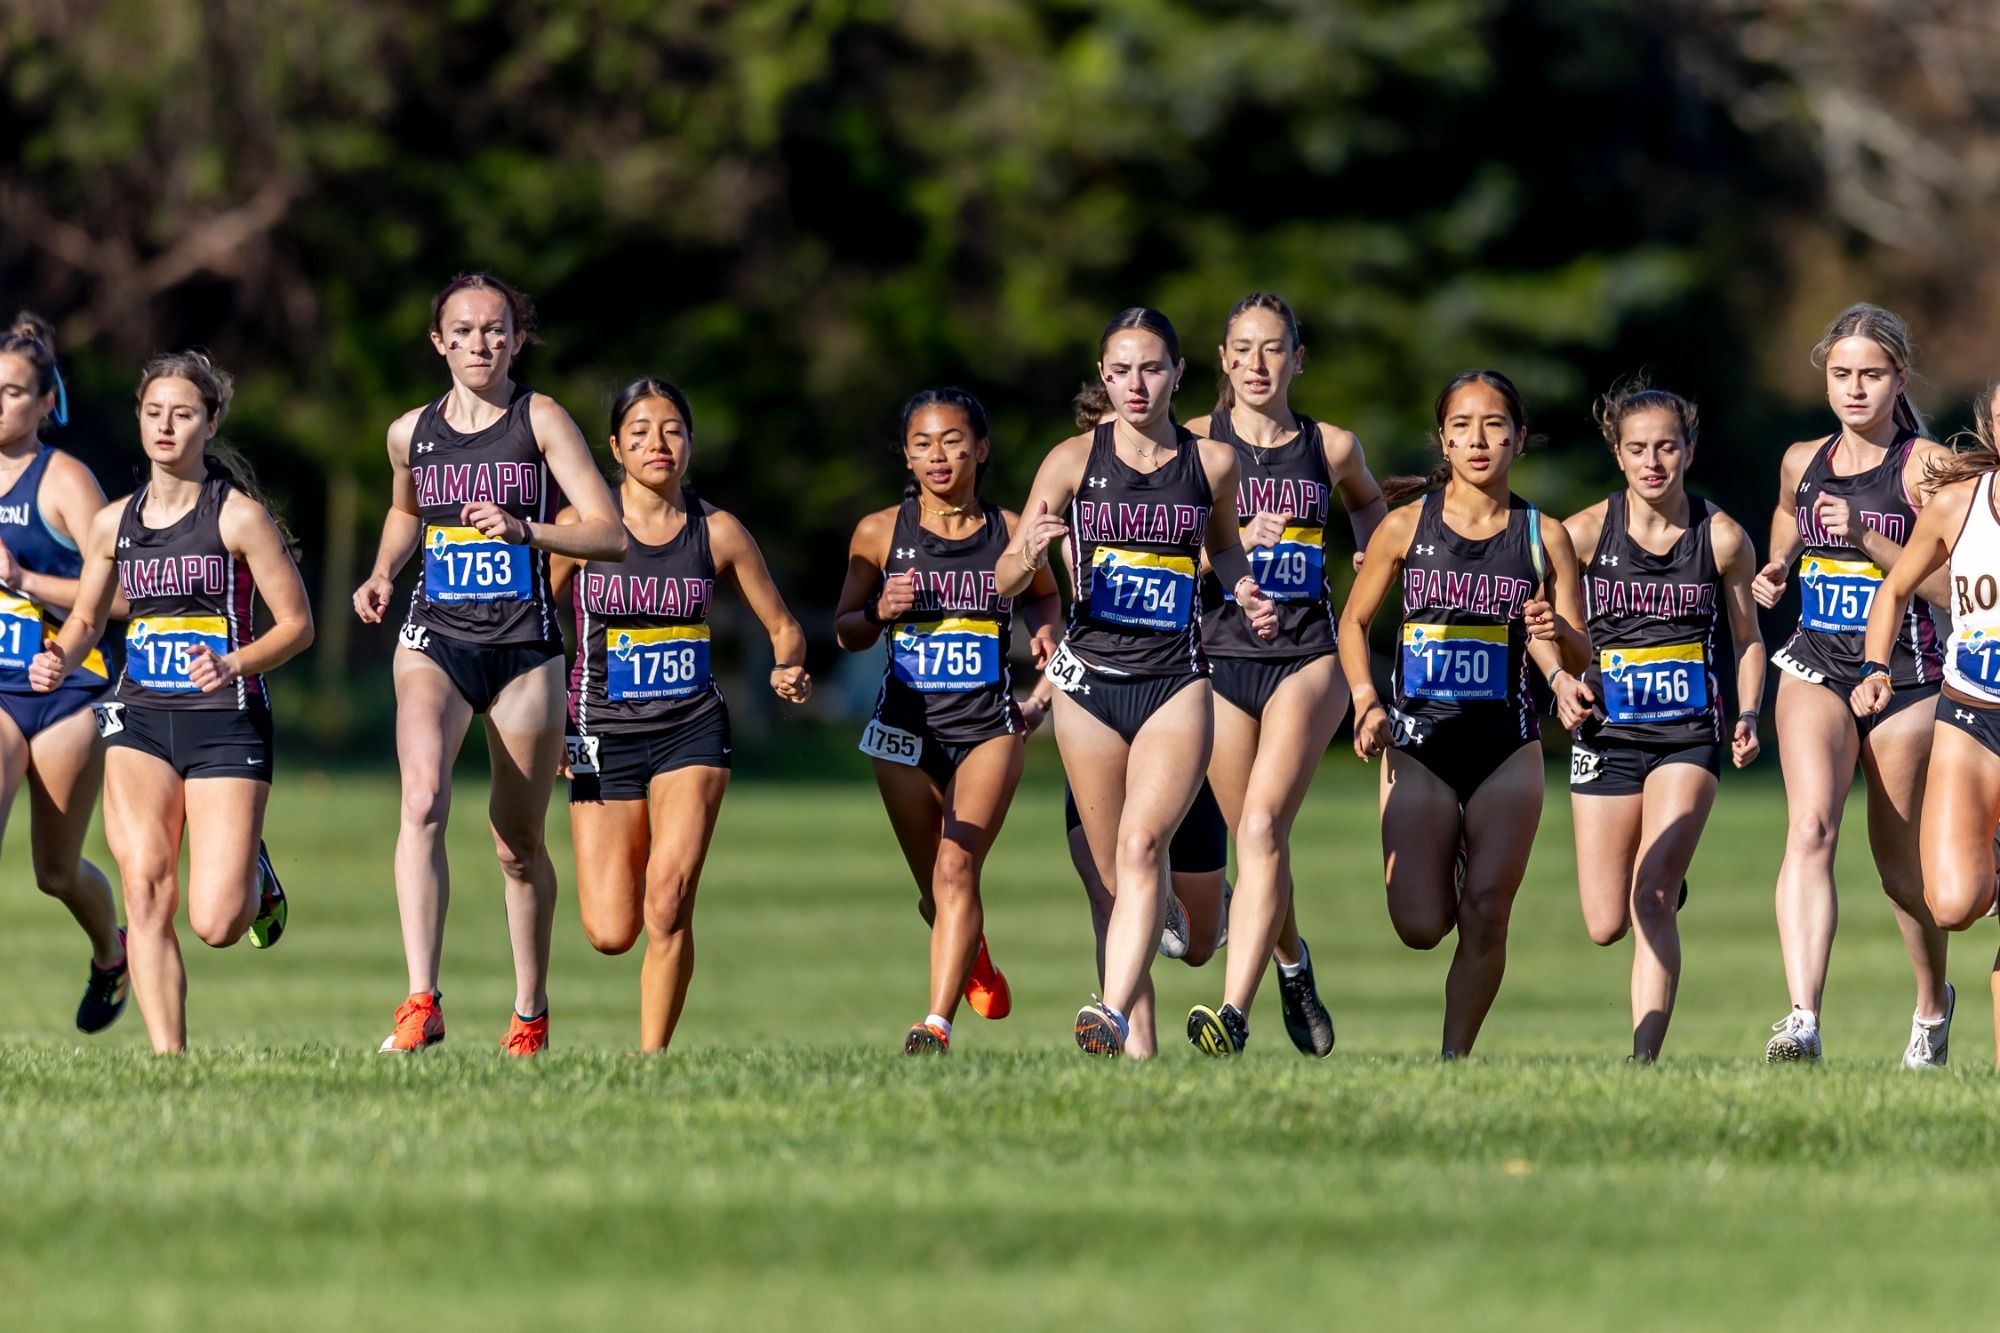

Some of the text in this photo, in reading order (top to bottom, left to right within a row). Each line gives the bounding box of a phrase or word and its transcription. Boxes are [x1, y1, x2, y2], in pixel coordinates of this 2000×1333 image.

[412, 463, 537, 507] RAMAPO
[1236, 478, 1328, 523] AMAPO
[1081, 501, 1208, 545] RAMAPO
[117, 556, 223, 599] AMAPO
[444, 551, 512, 586] 1753
[587, 573, 714, 617] RAMAPO
[1112, 573, 1177, 614] 1754
[1409, 569, 1532, 619] RAMAPO
[1594, 577, 1713, 620] RAMAPO
[1814, 582, 1876, 620] 1757
[1956, 574, 1998, 617] RO
[144, 641, 205, 675] 175
[628, 648, 696, 685] 1758
[913, 641, 982, 676] 1755
[1422, 648, 1490, 684] 1750
[1621, 668, 1690, 706] 1756
[867, 724, 915, 758] 1755
